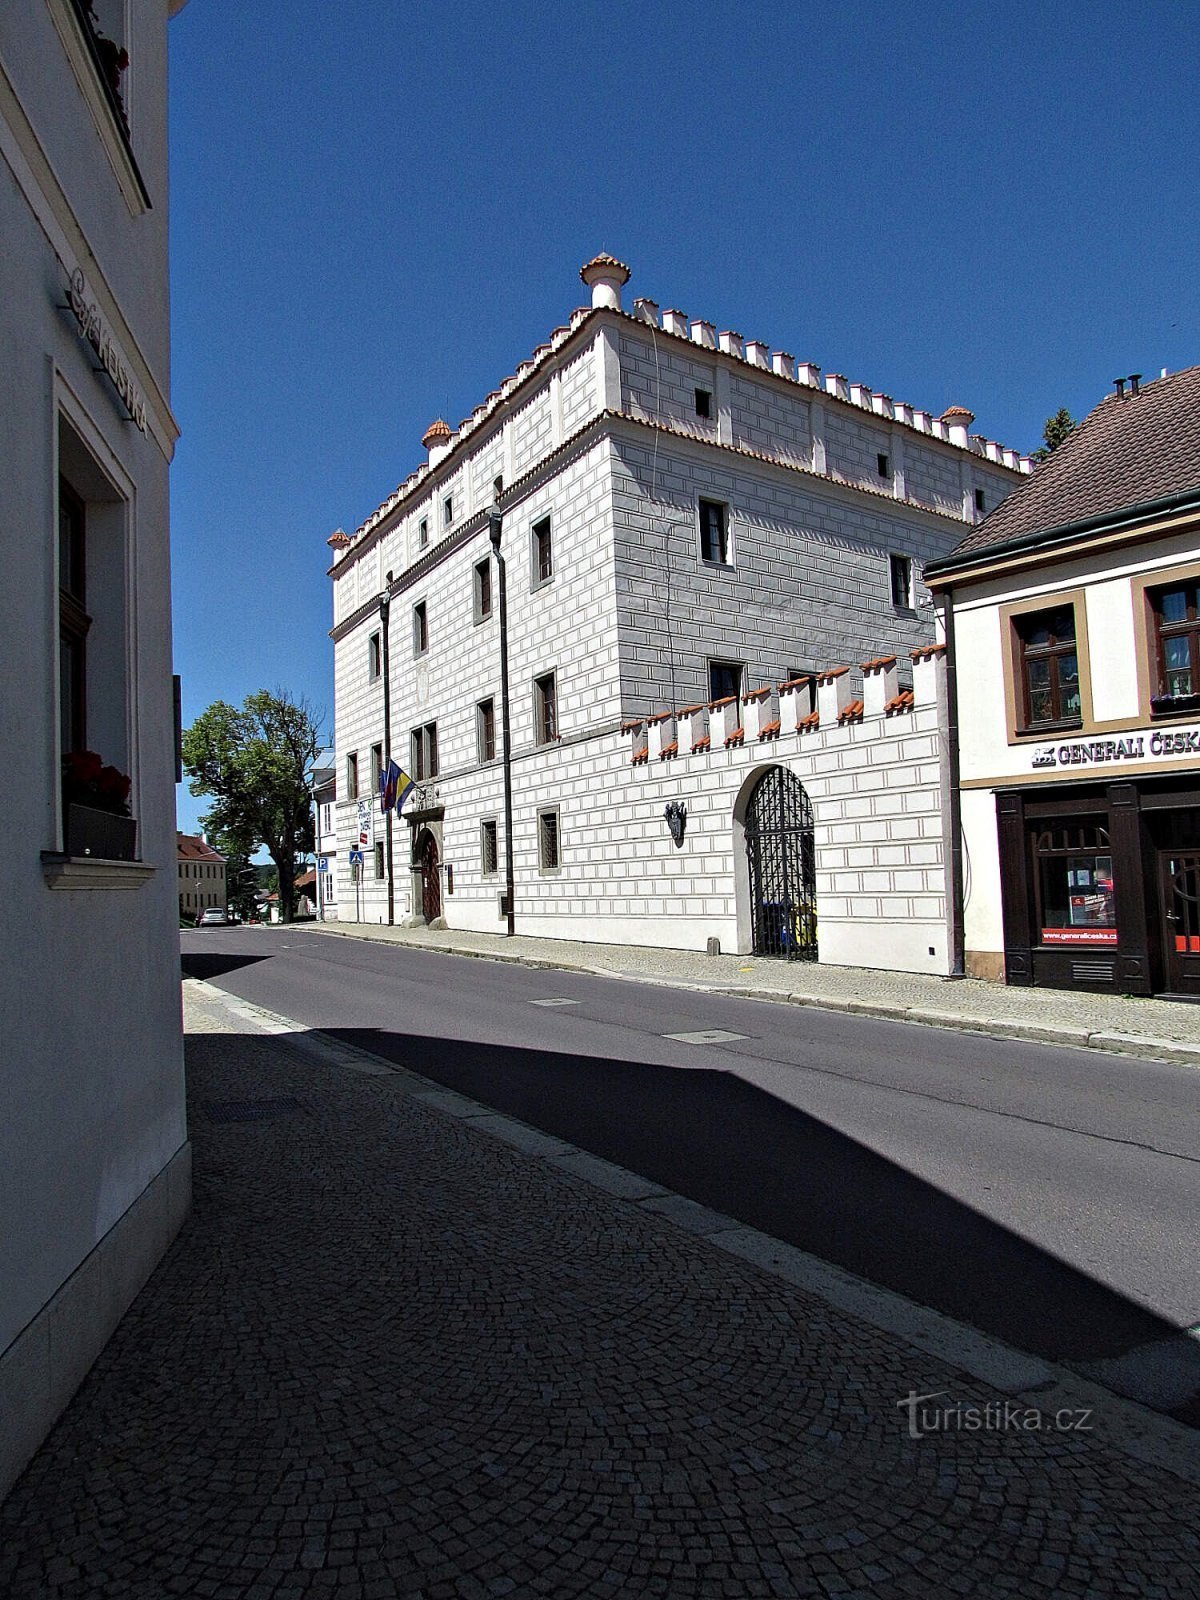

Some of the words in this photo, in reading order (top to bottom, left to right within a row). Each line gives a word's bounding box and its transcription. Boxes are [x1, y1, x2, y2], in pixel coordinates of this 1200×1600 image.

[1058, 737, 1144, 765] GENERALI
[1150, 731, 1200, 756] ČESK
[319, 859, 326, 868] P
